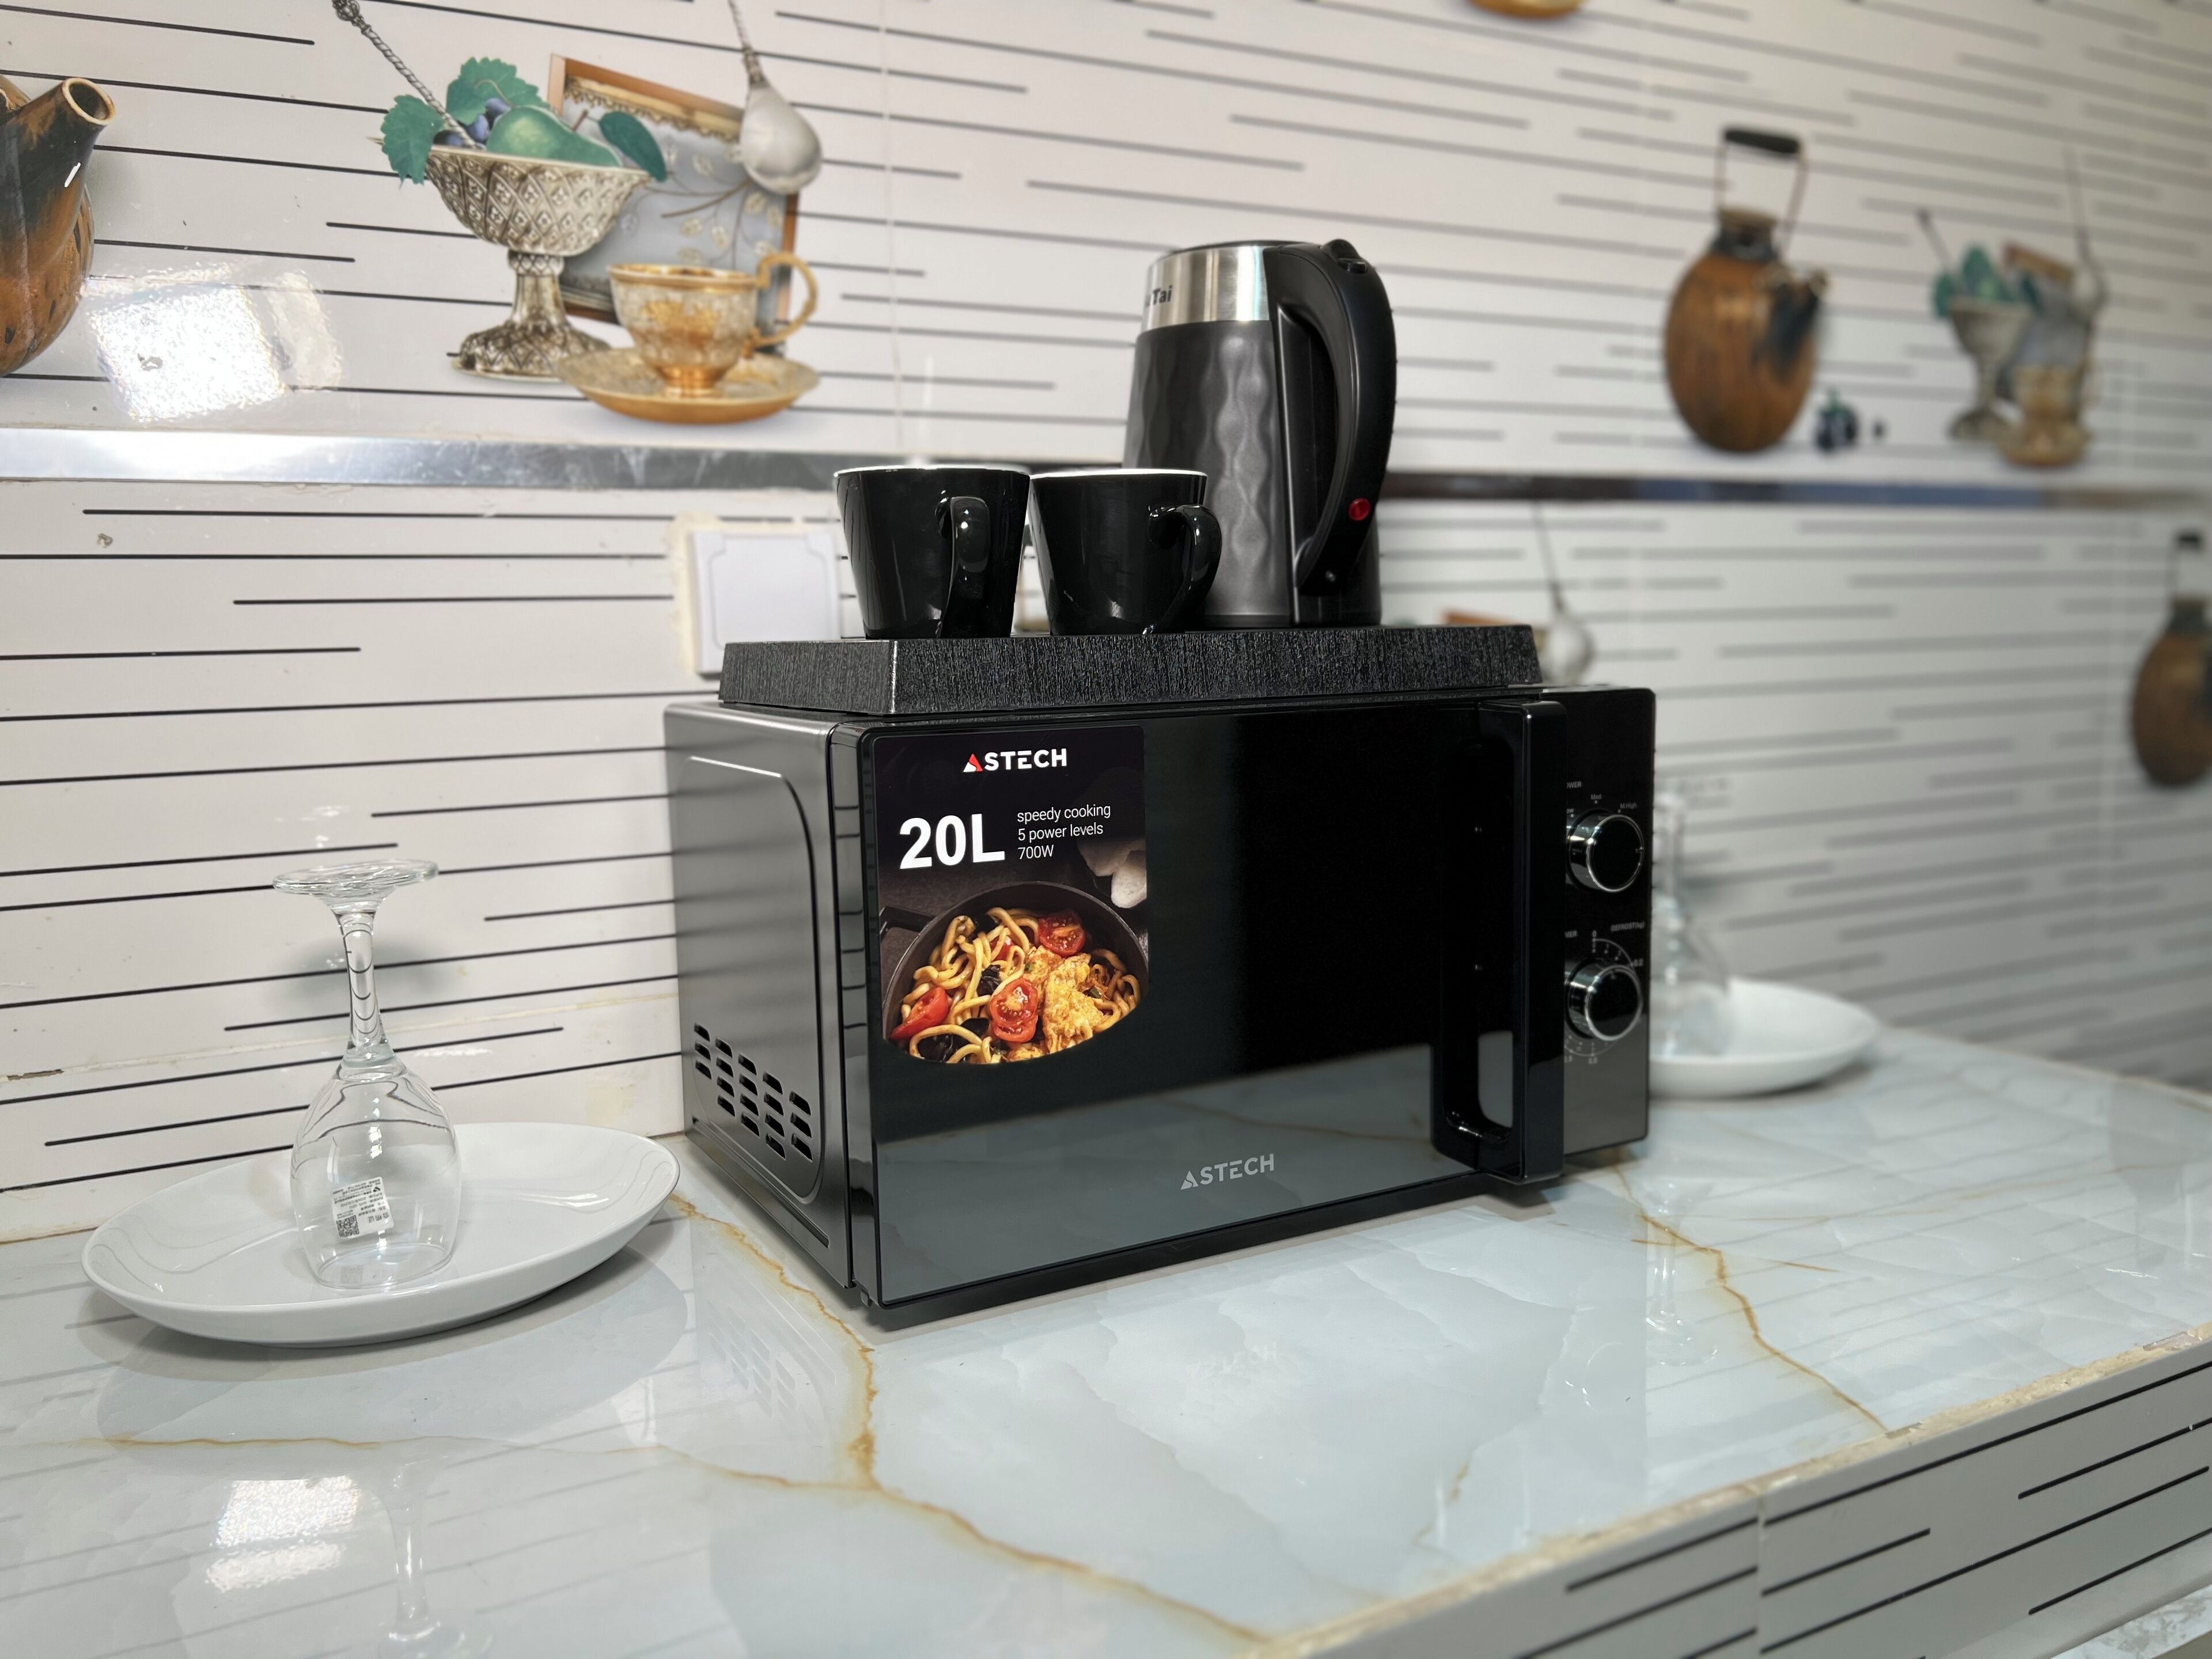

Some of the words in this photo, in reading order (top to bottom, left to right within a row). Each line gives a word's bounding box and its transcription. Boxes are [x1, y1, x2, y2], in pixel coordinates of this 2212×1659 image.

[1146, 285, 1172, 306] Tai
[963, 748, 1067, 772] ASTECH
[1017, 807, 1060, 824] speedy
[1064, 804, 1111, 820] cooking
[899, 813, 1005, 870] 20L
[1018, 828, 1026, 842] 5
[1029, 826, 1067, 843] power
[1070, 822, 1104, 837] levels
[1018, 844, 1054, 859] 700W
[1180, 1153, 1274, 1190] ASTECH
